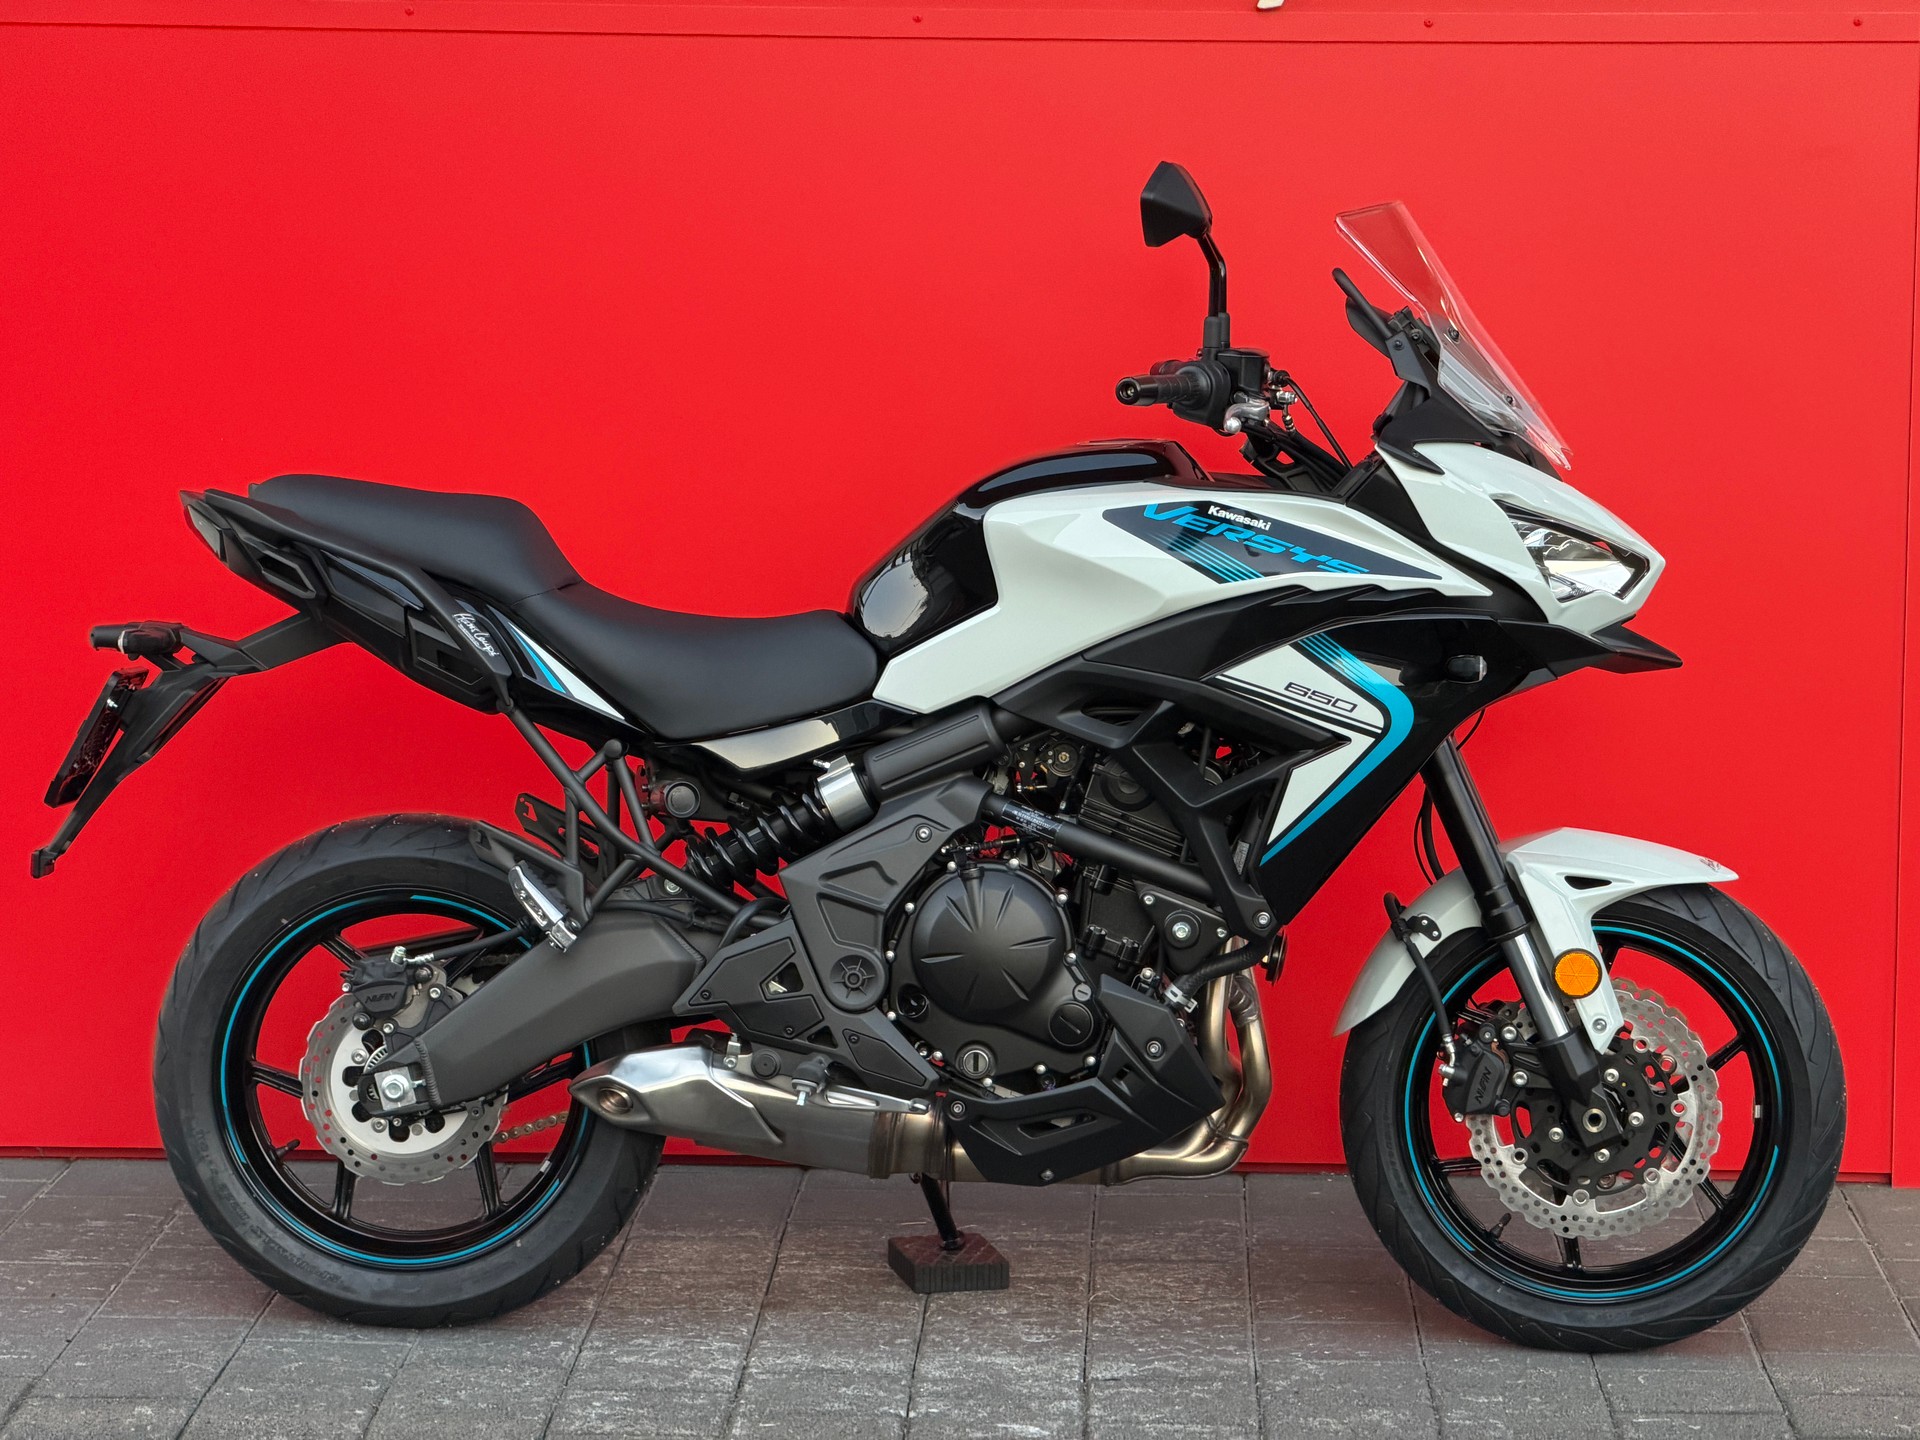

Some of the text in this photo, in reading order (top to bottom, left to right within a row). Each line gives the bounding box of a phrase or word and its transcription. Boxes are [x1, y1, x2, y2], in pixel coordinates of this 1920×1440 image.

[1207, 505, 1271, 530] Kawasaki
[1143, 503, 1370, 574] VERSYS
[1283, 681, 1358, 713] 650
